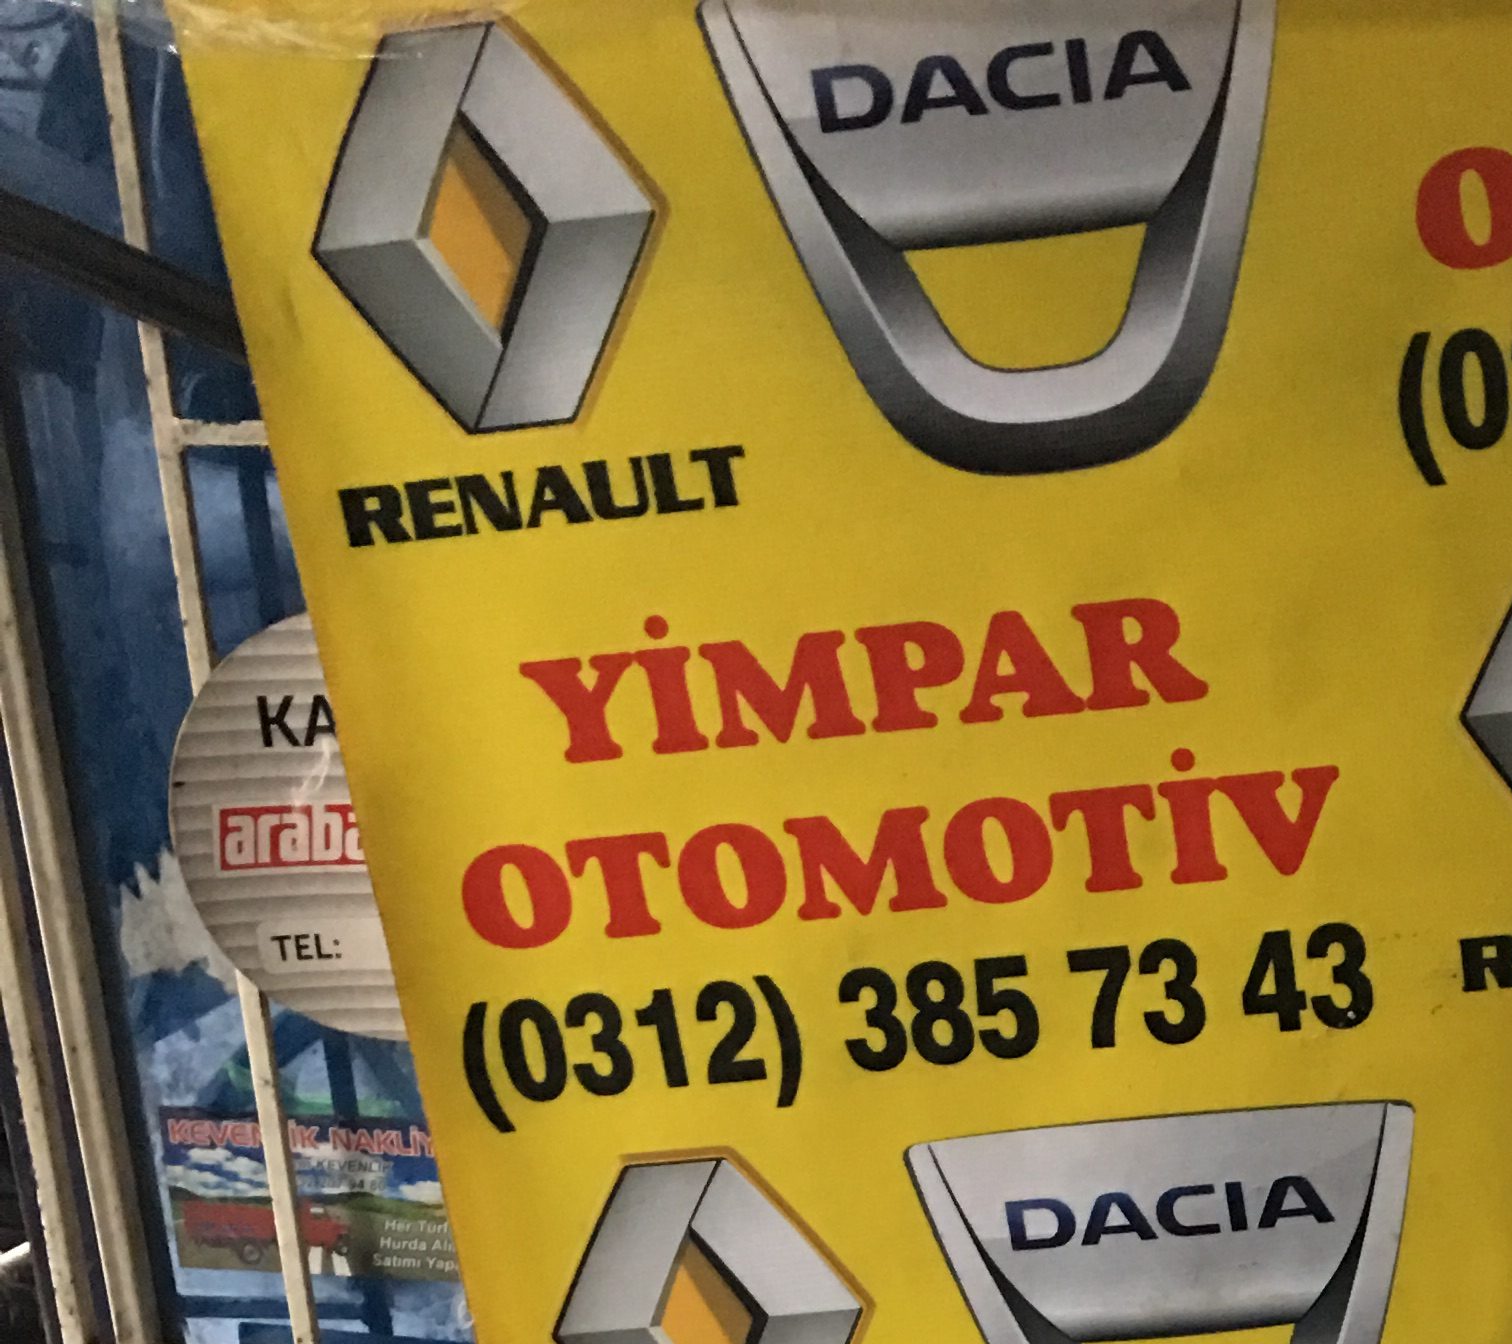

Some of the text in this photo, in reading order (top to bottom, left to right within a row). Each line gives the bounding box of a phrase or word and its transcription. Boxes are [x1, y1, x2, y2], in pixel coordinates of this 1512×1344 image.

[811, 30, 1191, 133] DACIA
[338, 445, 745, 548] RENAULT
[519, 598, 1209, 764] YİMPAR
[461, 747, 1340, 949] OTOMOTİV
[271, 933, 342, 961] TEL:
[462, 922, 1375, 1132] (0312) 385 73 43
[167, 1119, 320, 1151] KEVENİK
[1004, 1175, 1334, 1250] DACIA
